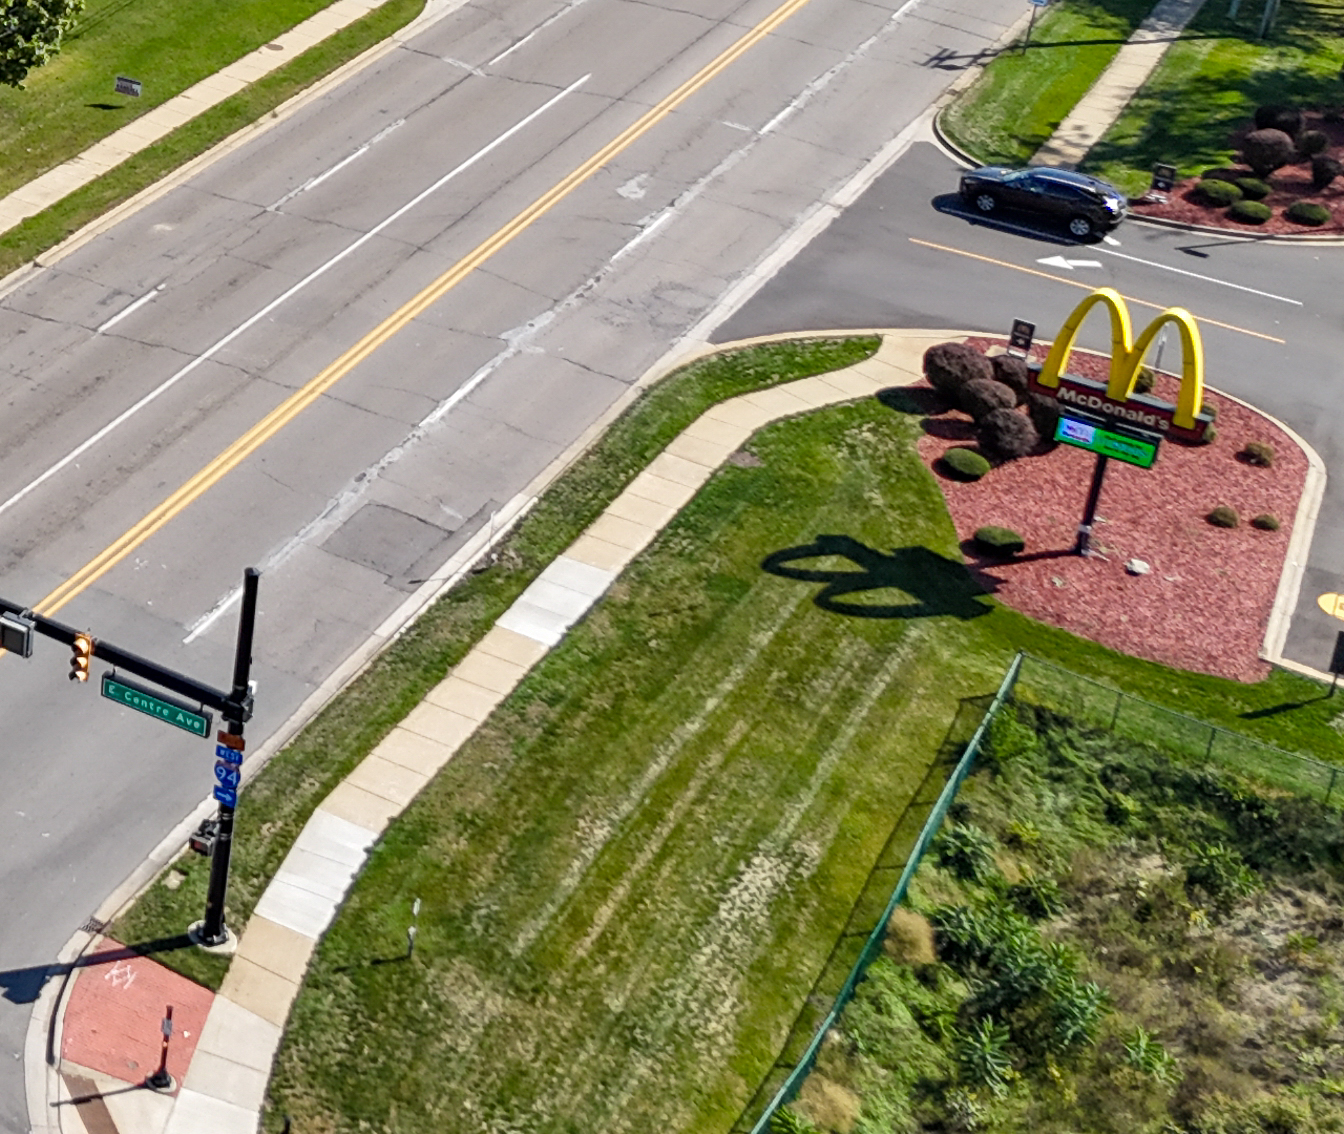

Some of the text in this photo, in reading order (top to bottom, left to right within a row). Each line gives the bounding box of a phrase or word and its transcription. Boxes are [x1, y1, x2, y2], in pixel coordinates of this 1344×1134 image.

[1056, 387, 1170, 431] McDonald's
[124, 691, 169, 716] Centre
[176, 713, 200, 729] Ave
[219, 749, 239, 762] WEST
[216, 766, 237, 785] 94
